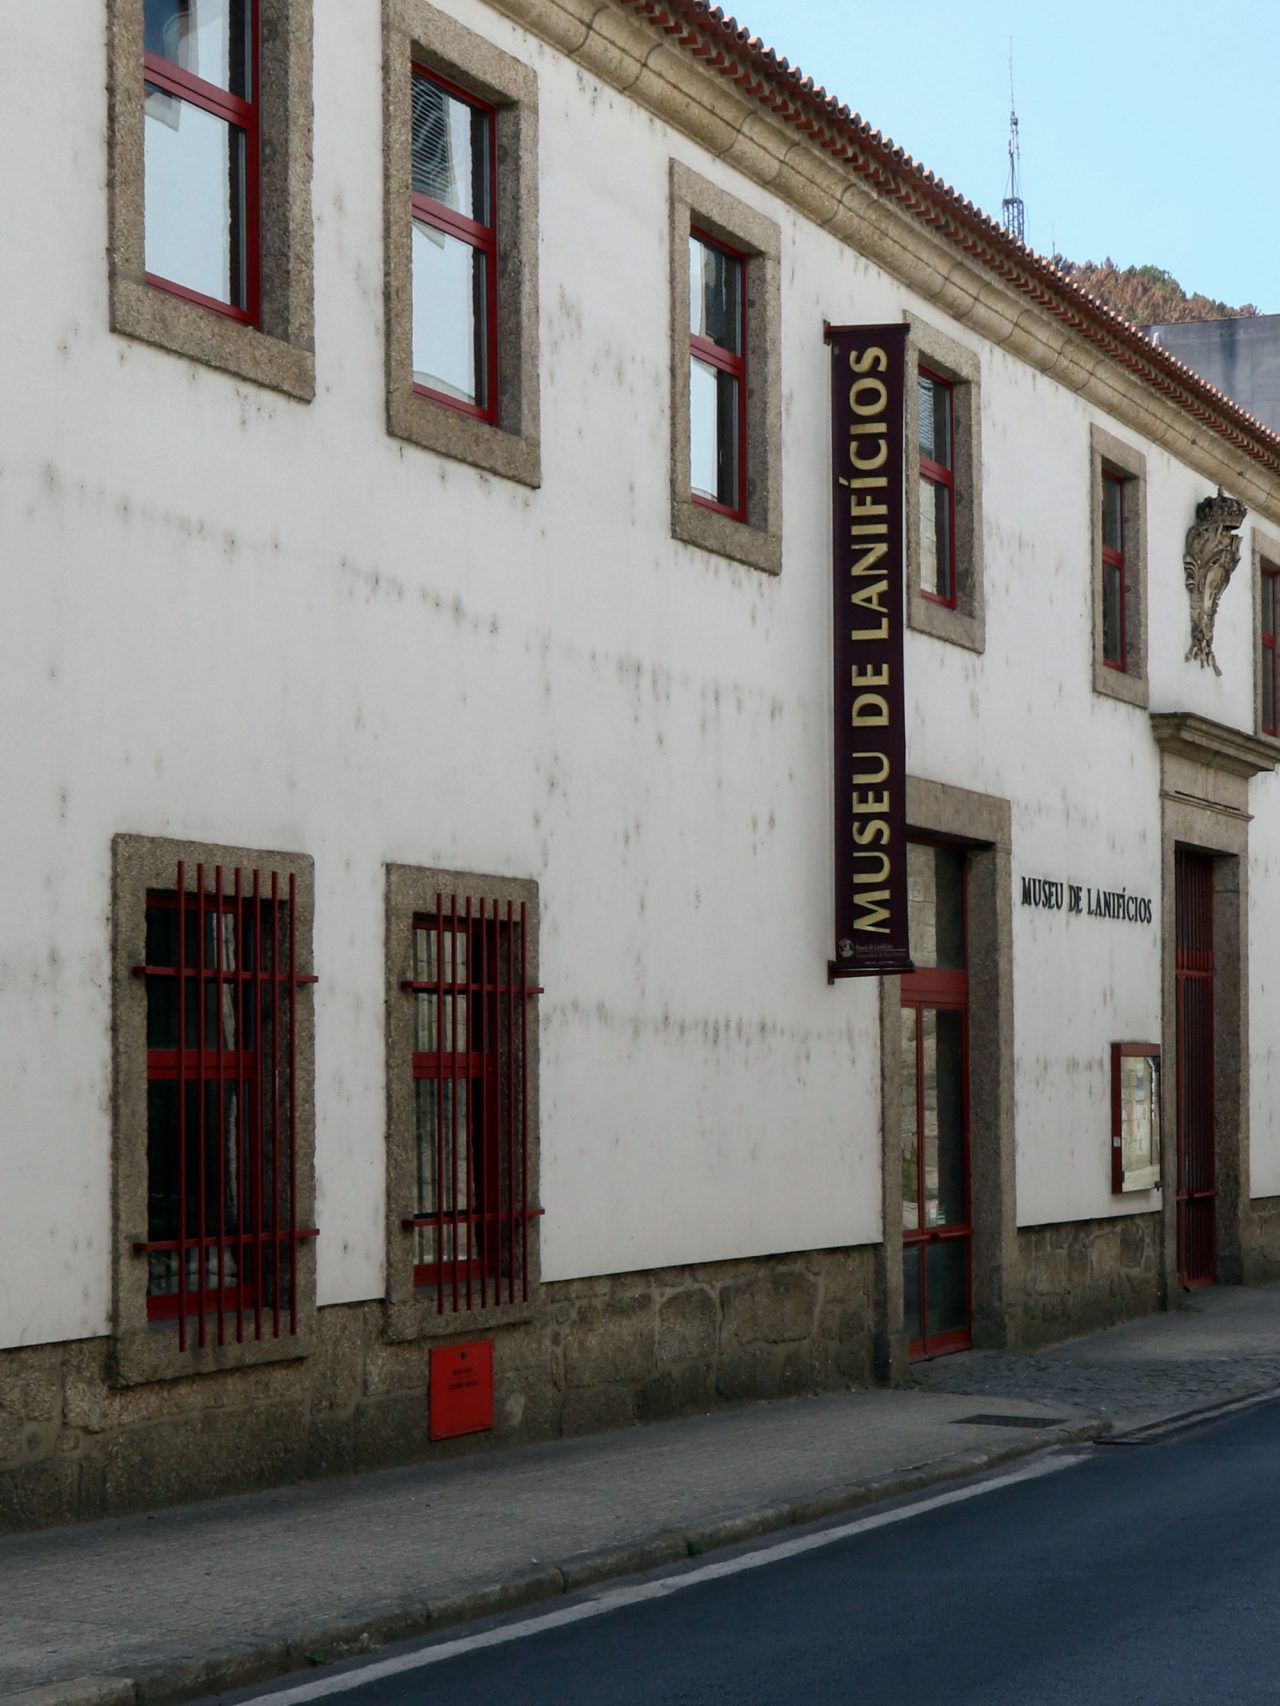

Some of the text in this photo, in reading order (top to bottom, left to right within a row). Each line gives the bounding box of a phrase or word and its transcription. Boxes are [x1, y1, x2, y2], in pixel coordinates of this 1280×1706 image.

[840, 346, 889, 641] LANIFÍCIOS
[851, 663, 890, 727] DE
[852, 751, 891, 934] MUSEU
[1021, 876, 1152, 924] MUSEU DE LANIFÍCIOS
